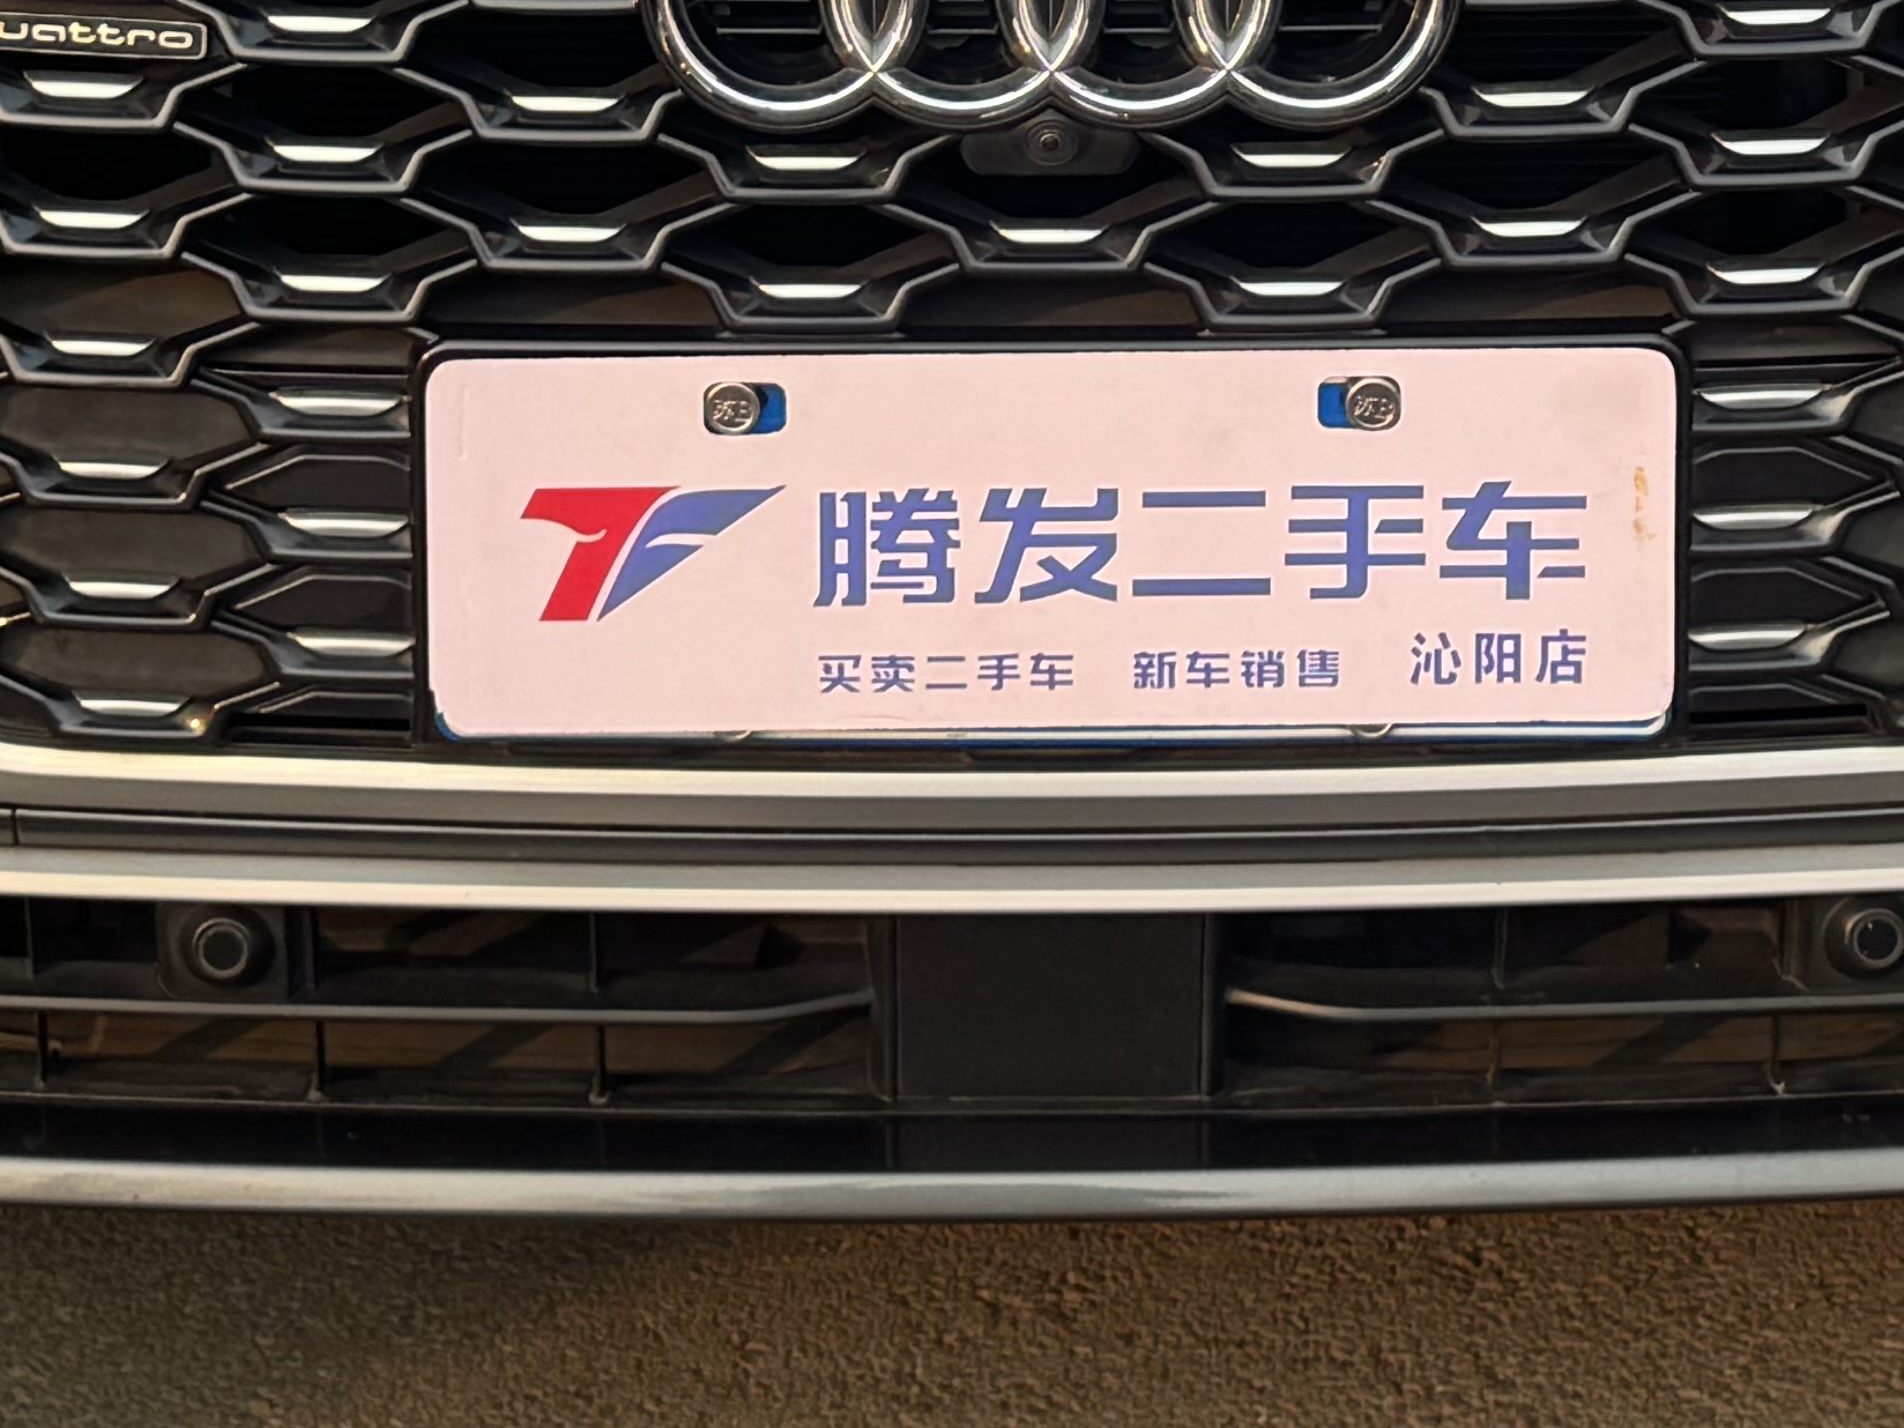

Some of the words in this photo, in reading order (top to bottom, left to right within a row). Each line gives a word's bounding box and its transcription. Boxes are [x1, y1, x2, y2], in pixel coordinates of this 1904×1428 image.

[813, 480, 1587, 607] 腾发二手车
[818, 653, 1075, 693] 买卖二手车
[1132, 649, 1340, 690] 新车销售
[1410, 628, 1587, 686] 沁阳店
